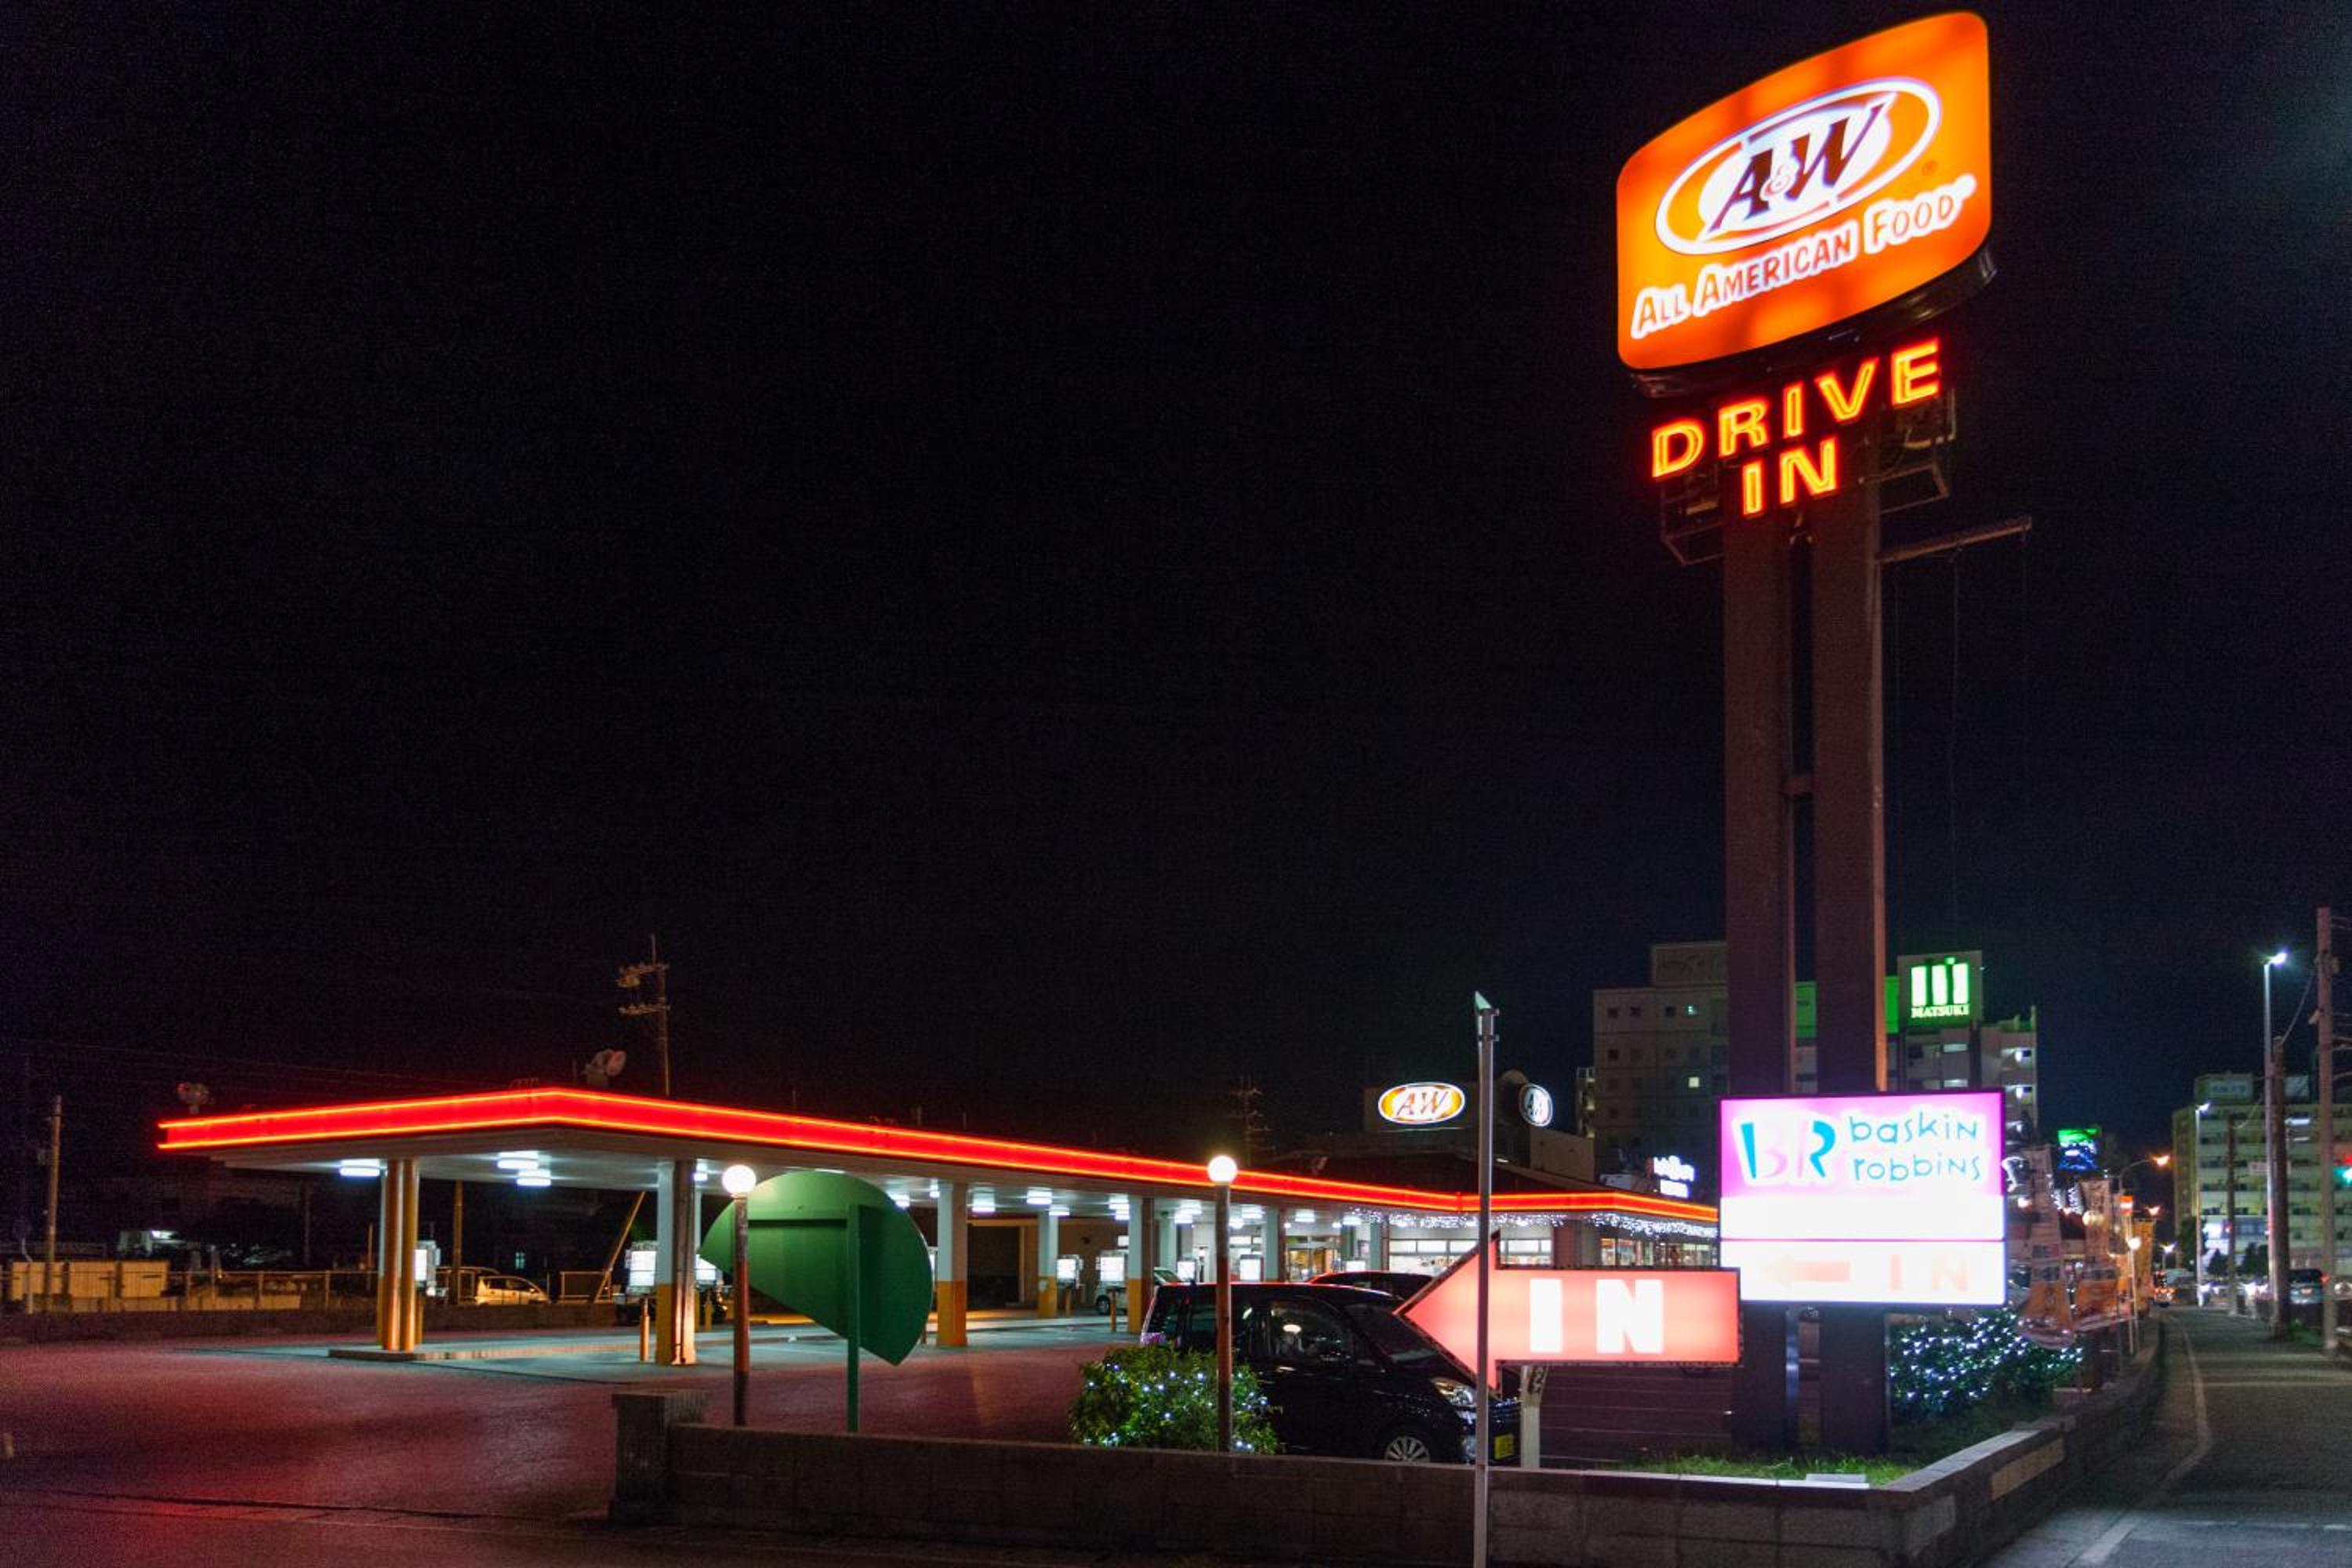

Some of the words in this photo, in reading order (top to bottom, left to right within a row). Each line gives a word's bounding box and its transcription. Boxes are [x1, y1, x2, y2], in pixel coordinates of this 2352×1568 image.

[1708, 101, 1889, 232] A&W
[1700, 229, 1851, 310] AMERICAN
[1872, 194, 1955, 246] FOOD
[1651, 337, 1942, 480] DRIVE
[1741, 436, 1838, 517] IN
[1849, 1111, 1979, 1143] baskin
[1853, 1151, 1982, 1181] robbins
[1529, 1278, 1664, 1355] IN
